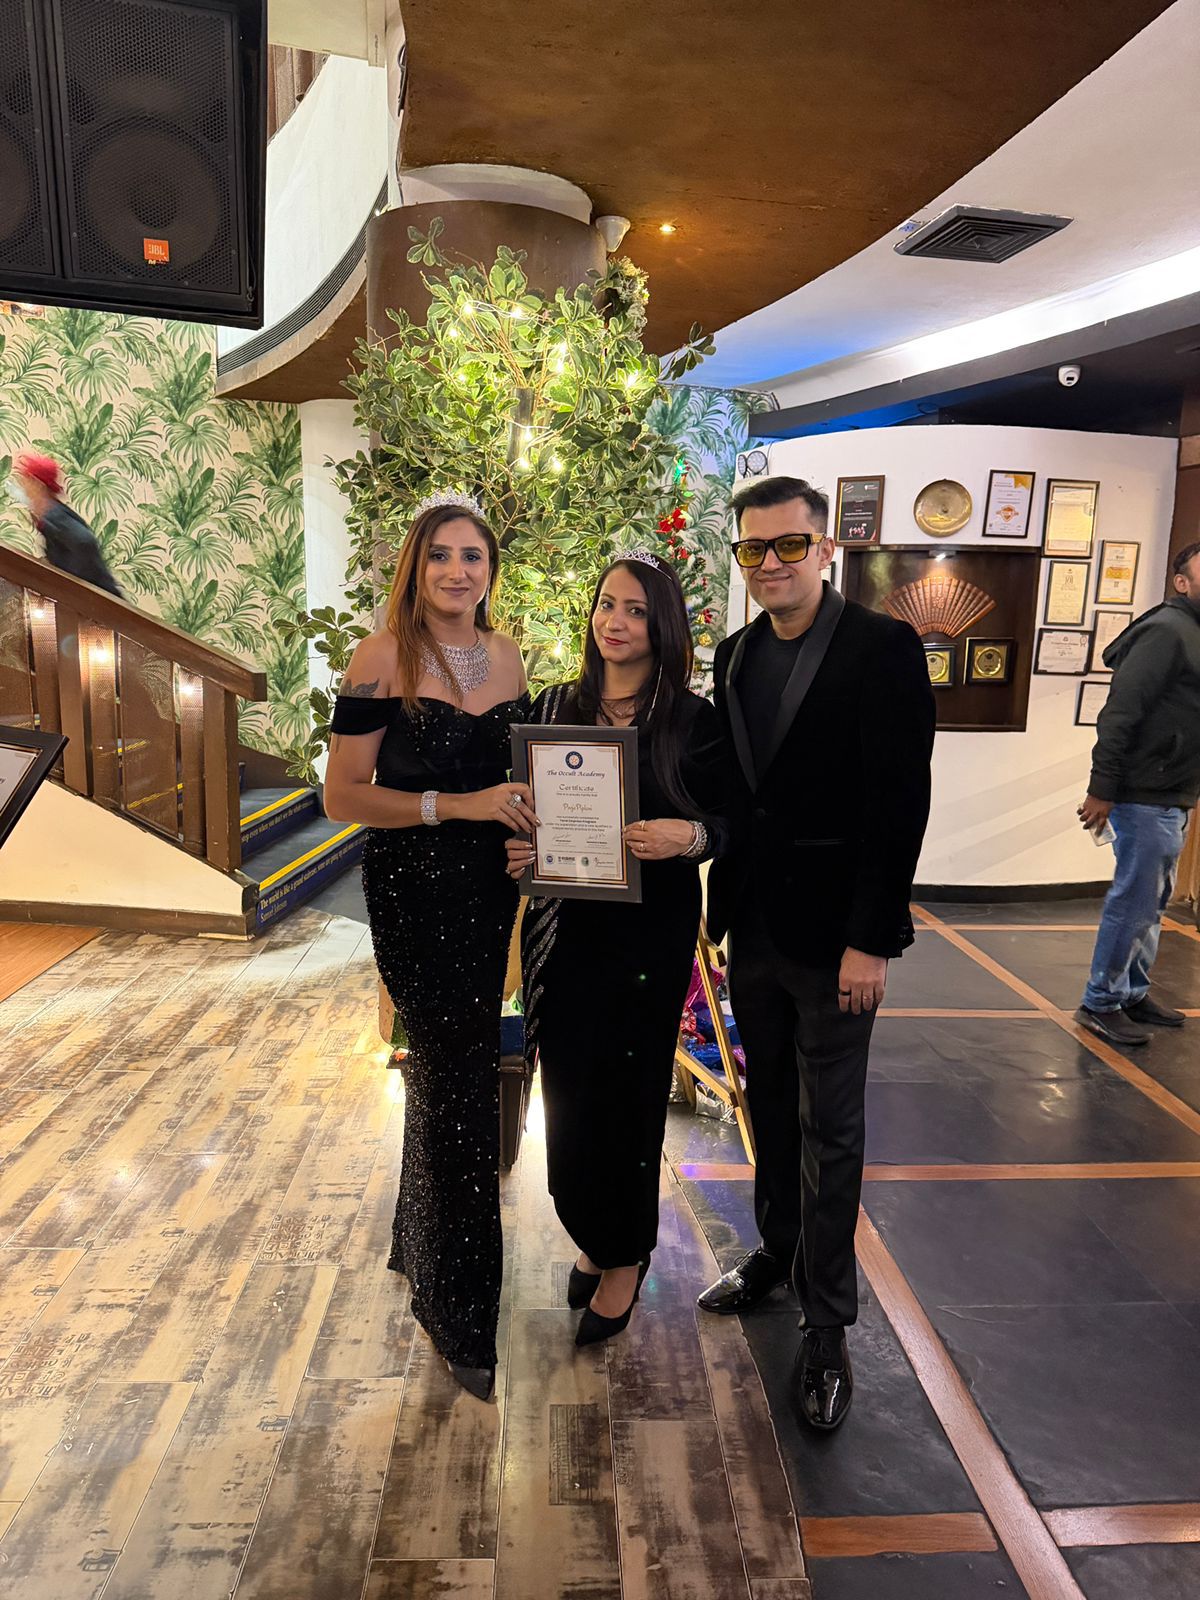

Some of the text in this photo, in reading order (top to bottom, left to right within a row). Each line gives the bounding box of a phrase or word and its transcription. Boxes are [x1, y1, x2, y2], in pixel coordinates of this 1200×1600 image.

[149, 244, 165, 256] JBL
[578, 771, 605, 779] Academy
[260, 898, 269, 910] The
